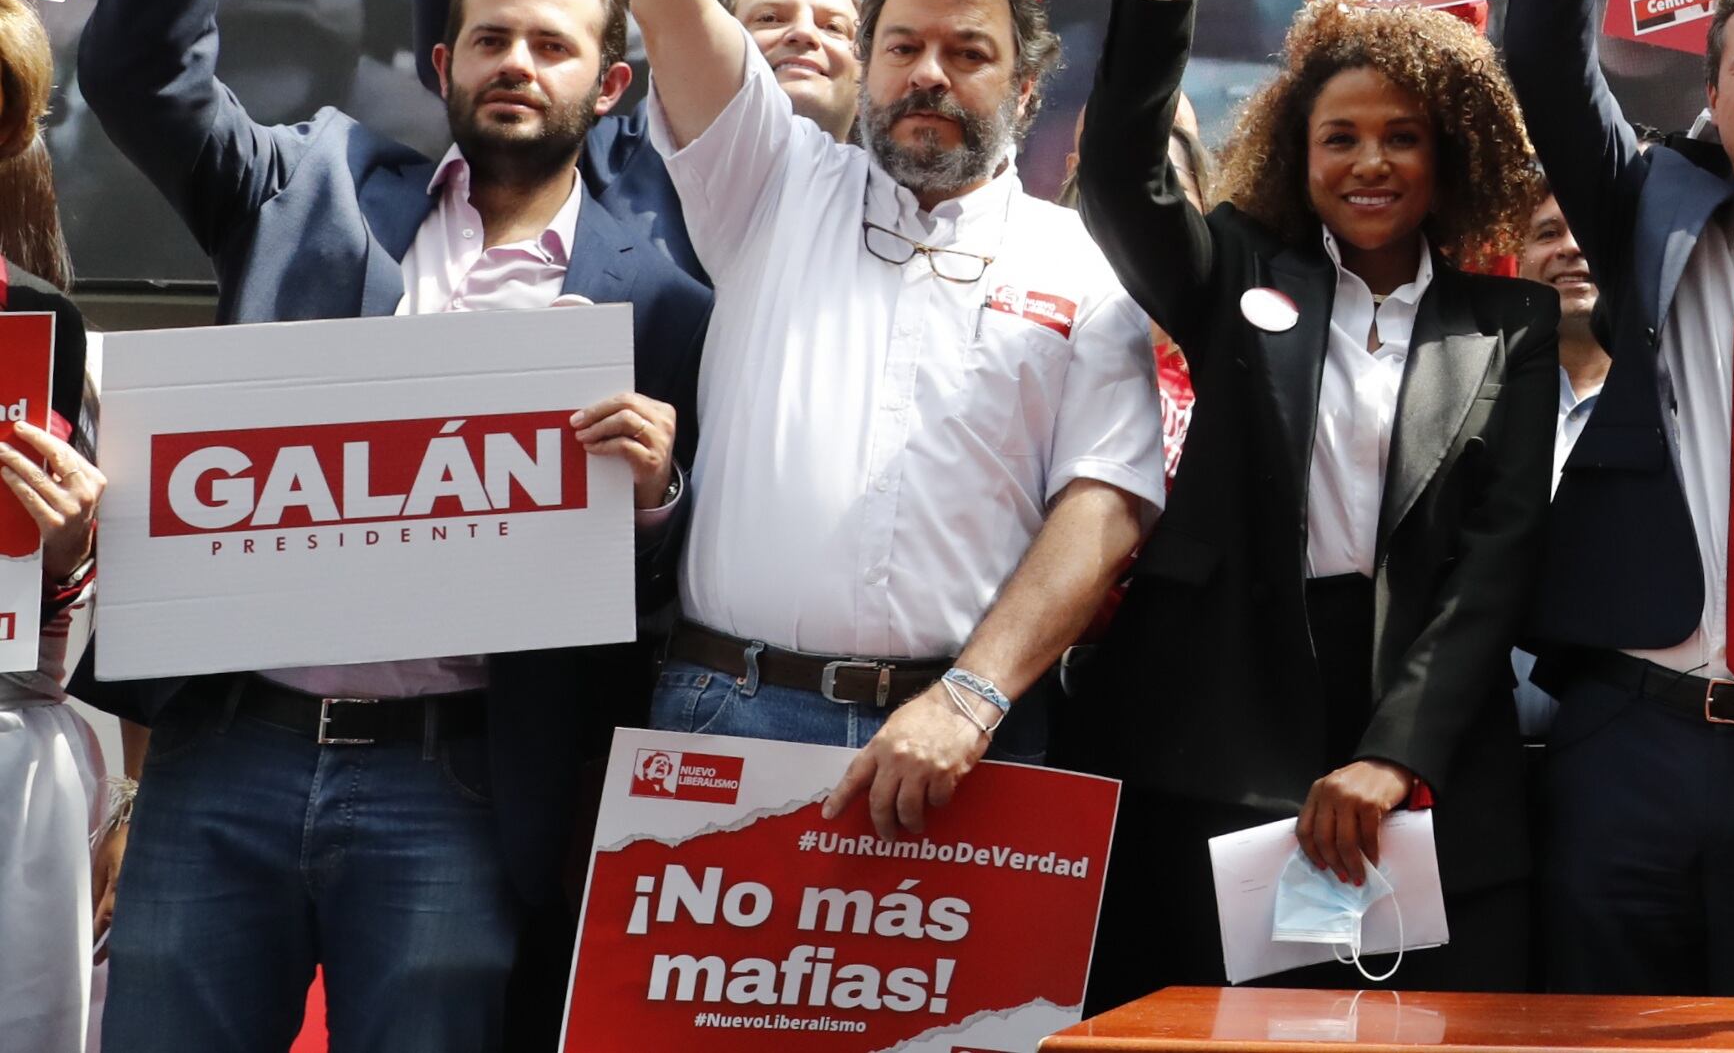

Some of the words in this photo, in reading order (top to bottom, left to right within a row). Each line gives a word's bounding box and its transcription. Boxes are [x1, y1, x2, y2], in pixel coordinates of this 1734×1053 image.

[168, 420, 561, 529] GALÁN
[212, 522, 508, 555] PRESIDENTE
[679, 776, 738, 789] LIBERALISMO
[680, 766, 716, 777] NUEVO
[799, 831, 1088, 878] #UnRumboDeVerdad
[627, 864, 772, 934] ¡No
[798, 880, 970, 941] más
[648, 945, 956, 1013] mafias!
[695, 1013, 866, 1032] #NuevoLiberalismo
